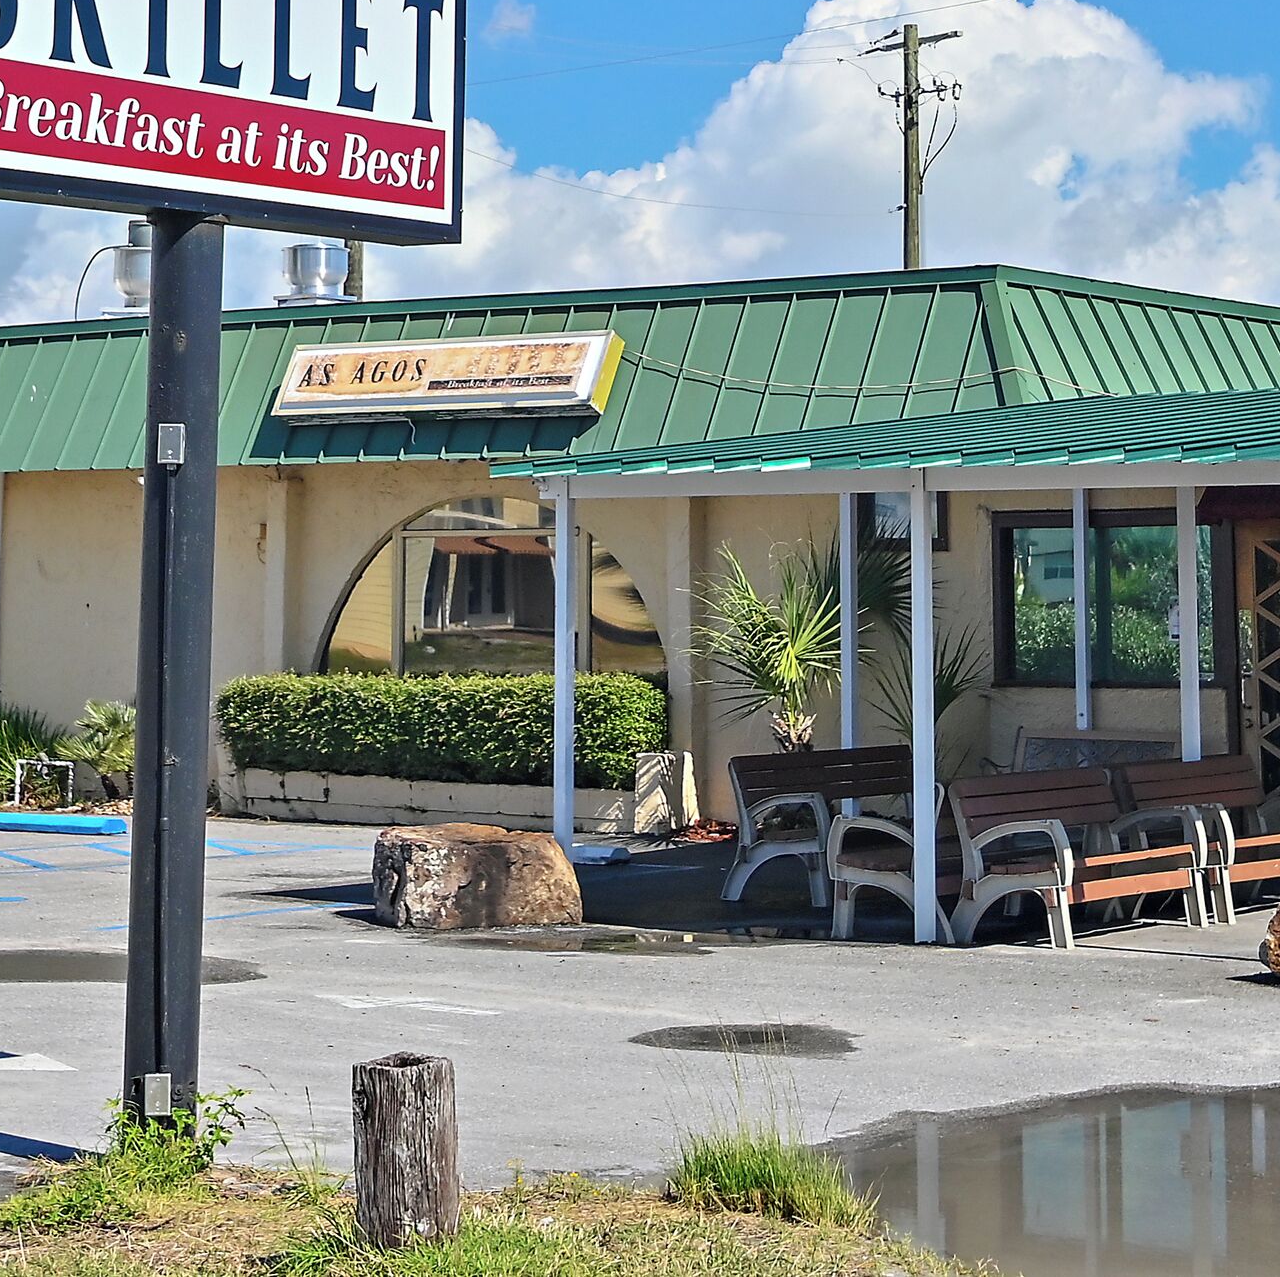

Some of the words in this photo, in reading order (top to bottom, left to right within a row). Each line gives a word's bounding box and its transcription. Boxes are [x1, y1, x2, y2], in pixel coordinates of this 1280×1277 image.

[216, 122, 264, 167] at
[272, 127, 330, 177] its
[338, 132, 440, 191] Best!
[447, 379, 493, 390] Breakfast
